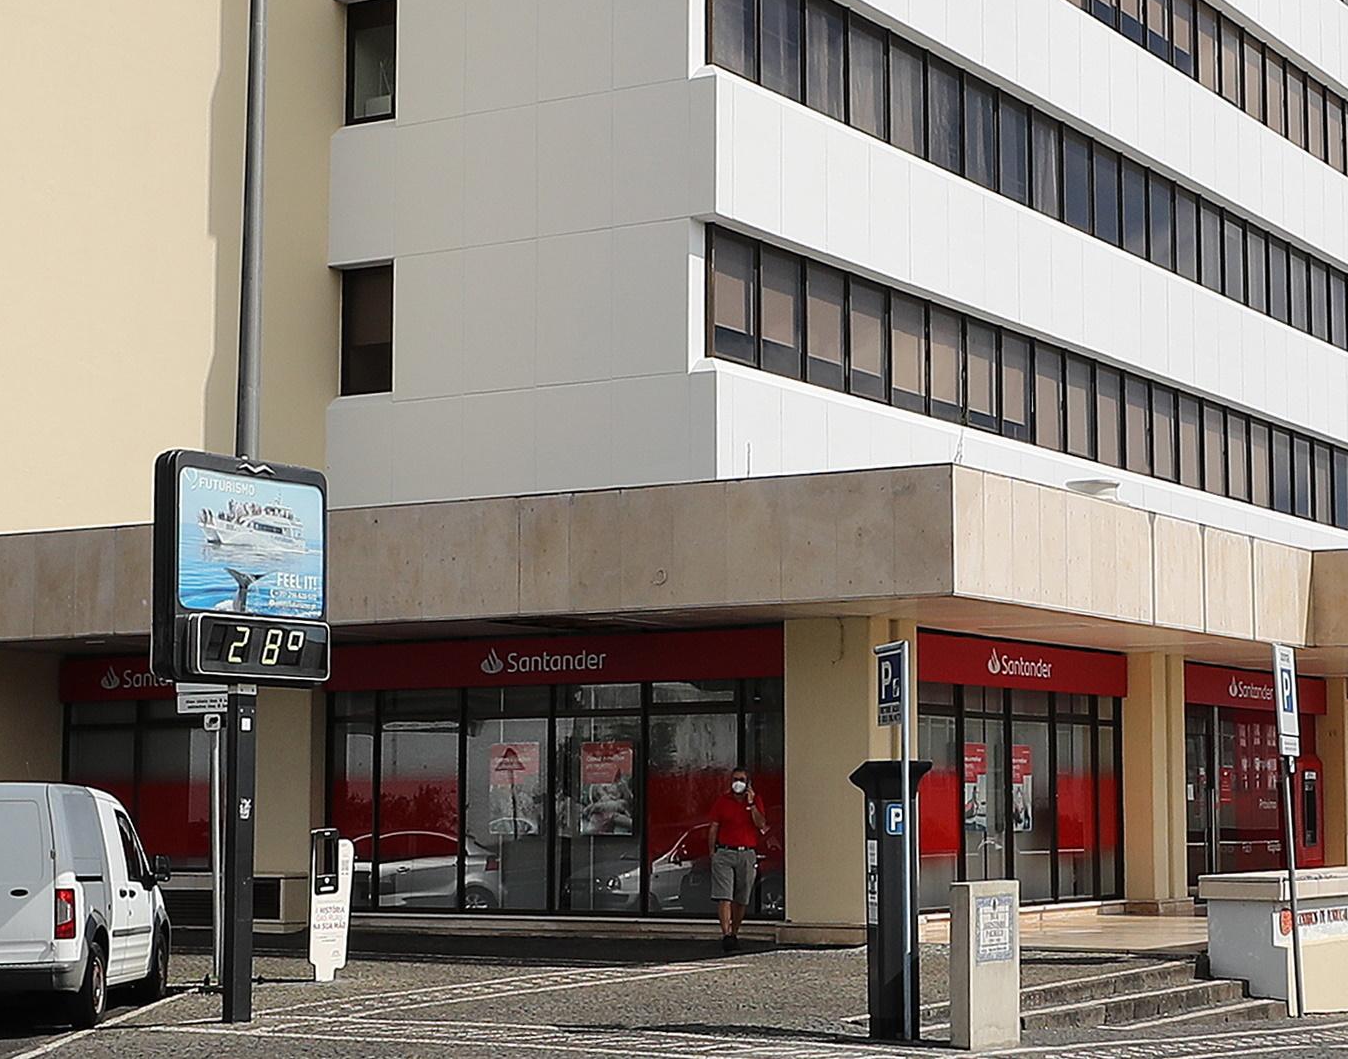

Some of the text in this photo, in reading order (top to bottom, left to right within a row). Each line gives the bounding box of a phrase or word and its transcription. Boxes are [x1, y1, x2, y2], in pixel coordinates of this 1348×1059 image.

[199, 477, 255, 496] FUTURISMO
[276, 571, 317, 591] FEEL IT!
[507, 650, 607, 673] Santander
[1001, 654, 1052, 678] Santander
[881, 660, 892, 699] P
[1238, 681, 1273, 700] Santander
[1282, 671, 1292, 709] P
[890, 807, 903, 831] P
